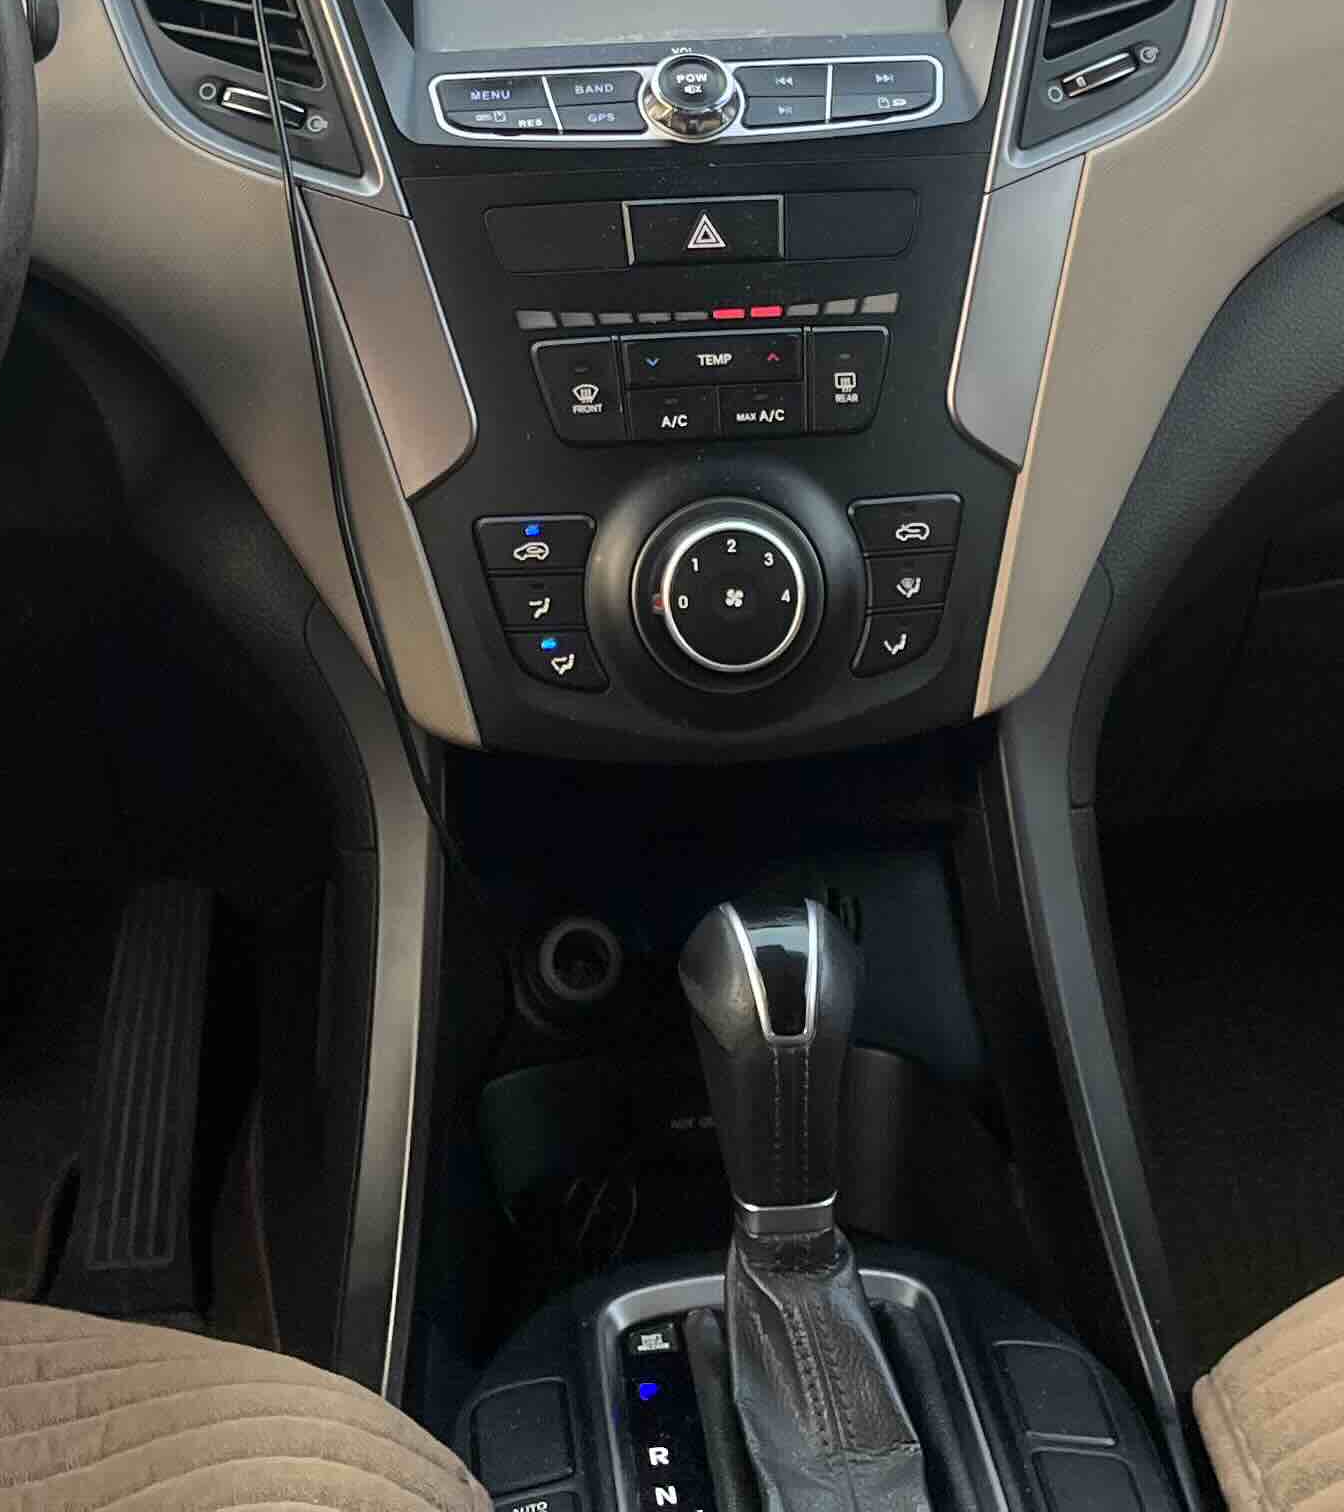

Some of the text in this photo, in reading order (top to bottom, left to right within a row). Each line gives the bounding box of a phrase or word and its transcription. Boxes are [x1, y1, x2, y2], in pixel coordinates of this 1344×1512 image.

[470, 89, 512, 101] MENU
[574, 84, 615, 95] BAND
[587, 112, 616, 123] GPS
[697, 353, 733, 367] TEMP
[834, 393, 859, 404] REAR
[571, 402, 603, 414] FRONT
[736, 408, 785, 423] MAX A/C
[661, 414, 688, 429] A/C
[726, 539, 738, 555] 2
[691, 558, 700, 573] 1
[764, 552, 775, 567] 3
[678, 595, 689, 610] 0
[780, 589, 791, 604] 4
[647, 1445, 669, 1466] R
[654, 1485, 678, 1506] N
